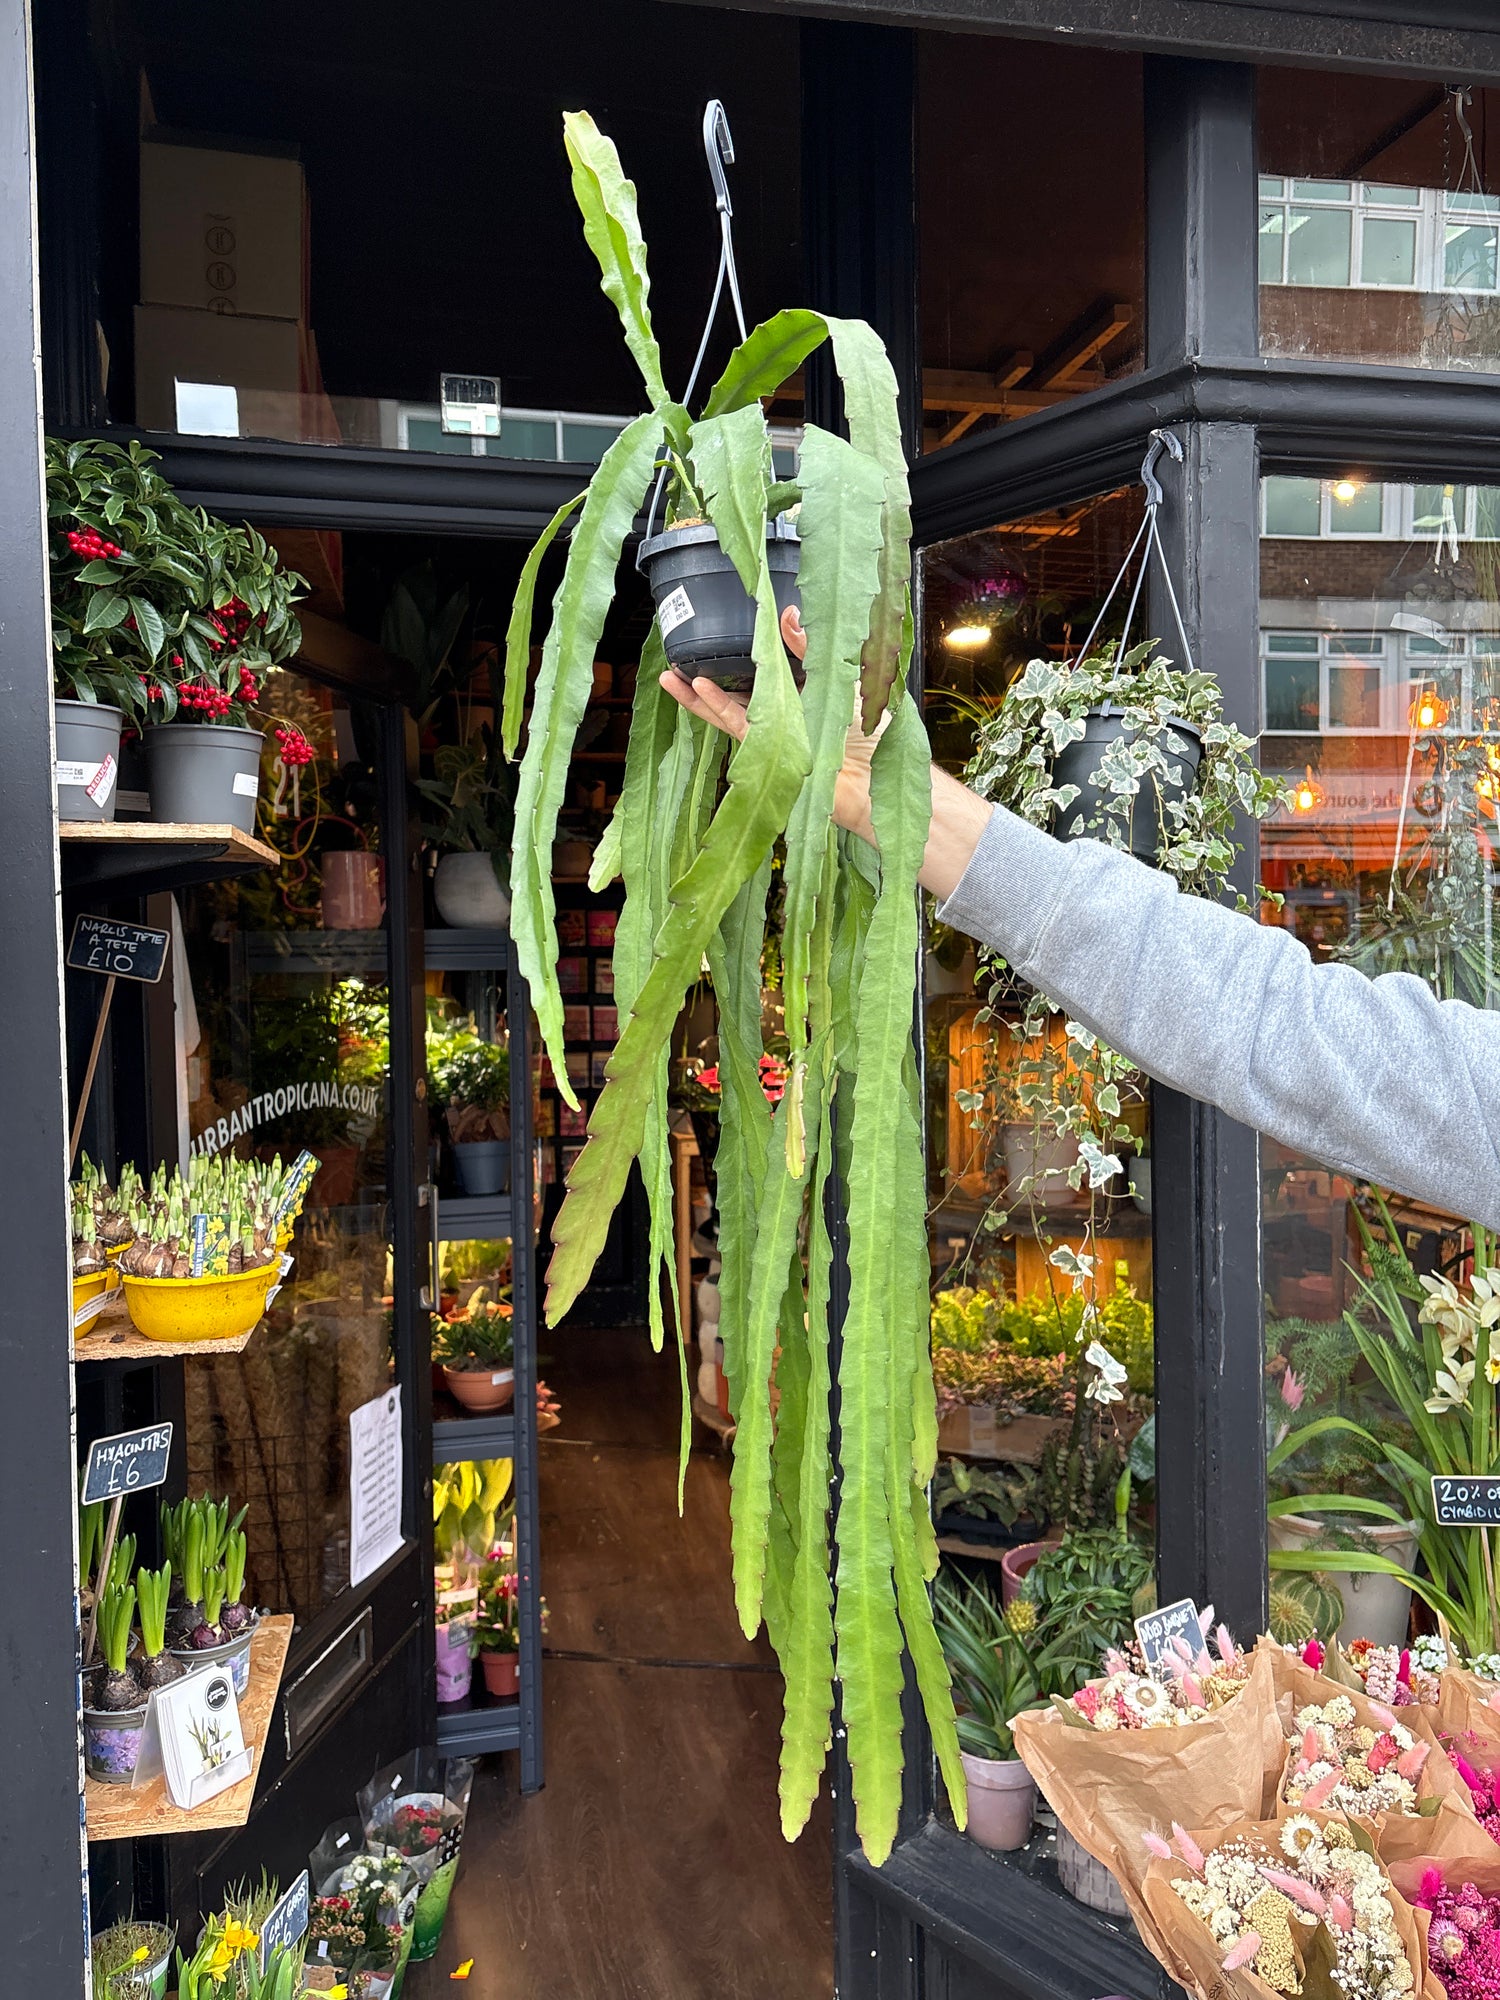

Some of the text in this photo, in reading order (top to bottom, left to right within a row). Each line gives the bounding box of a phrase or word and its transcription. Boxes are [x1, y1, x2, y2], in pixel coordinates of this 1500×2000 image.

[86, 754, 112, 797] REDUCED
[273, 756, 300, 817] 21
[81, 920, 166, 945] NARCIS TETE
[88, 933, 139, 953] A TETE
[87, 947, 133, 972] £10
[190, 1081, 379, 1157] URBANTROPICANA.CO.UK
[107, 1457, 140, 1493] £6
[1440, 1480, 1481, 1502] 20%
[269, 1904, 287, 1944] CAT
